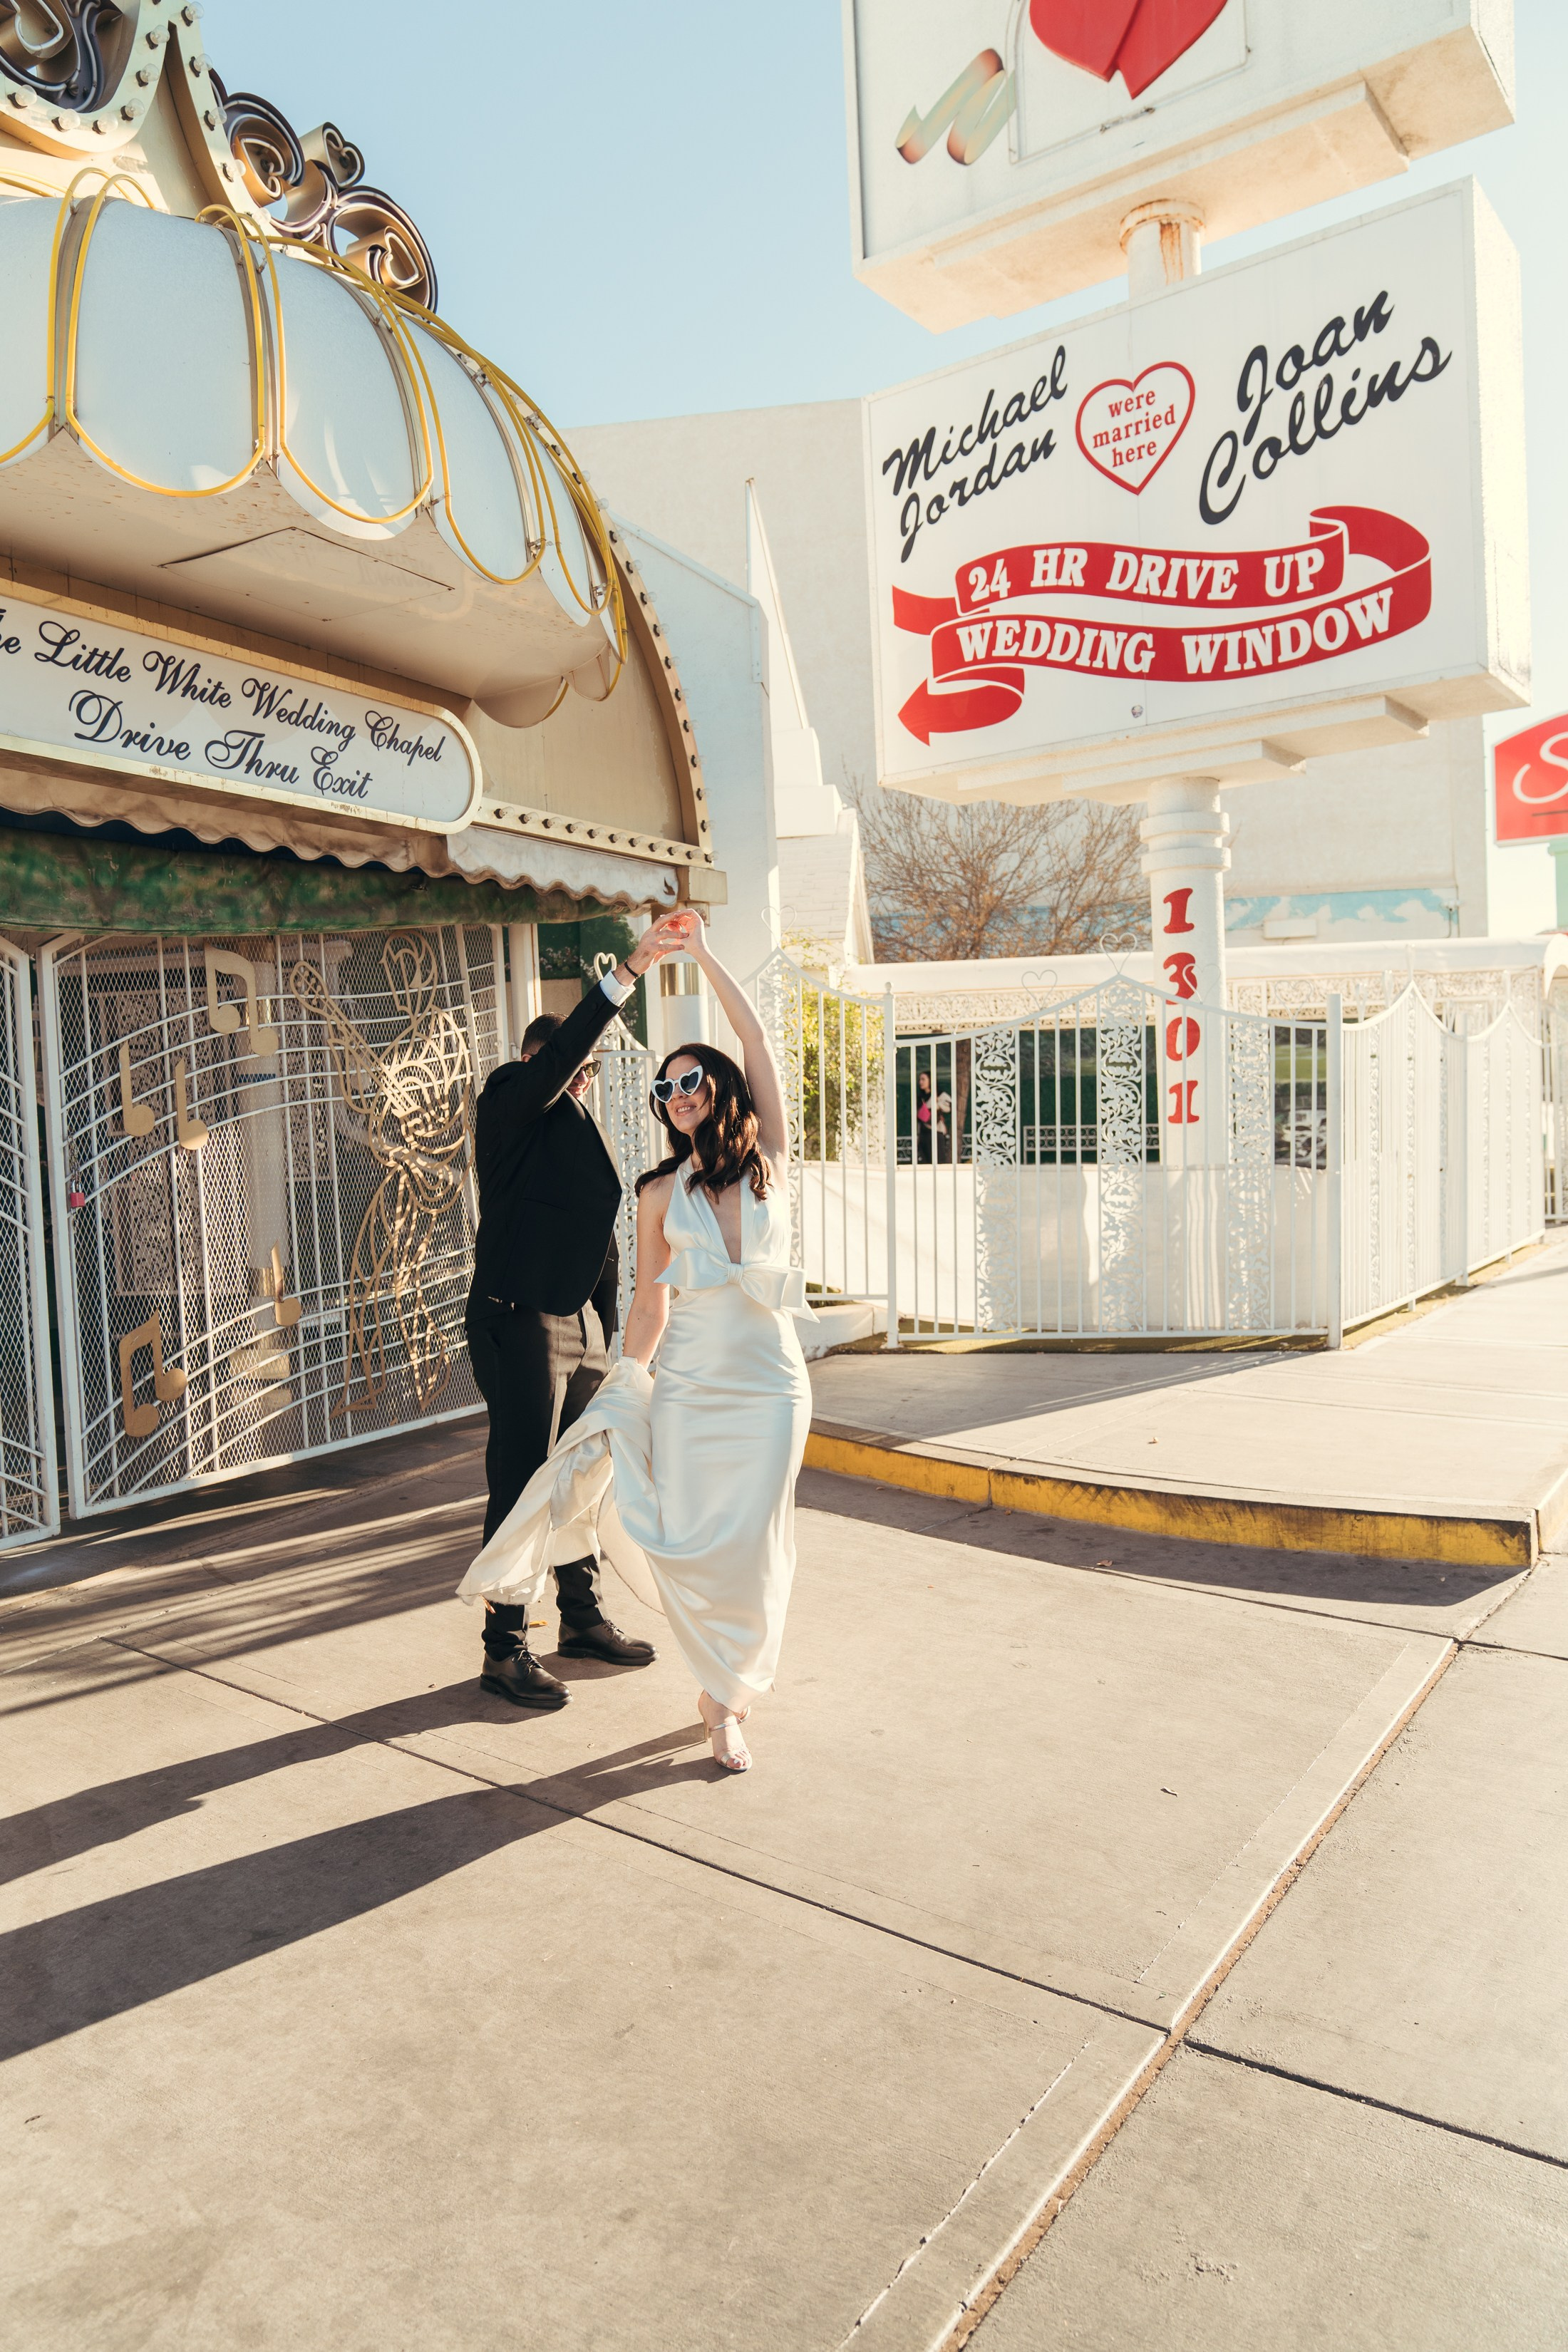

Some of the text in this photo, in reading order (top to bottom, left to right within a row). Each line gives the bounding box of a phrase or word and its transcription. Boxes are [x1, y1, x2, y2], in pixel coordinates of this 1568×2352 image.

[882, 345, 1068, 497] Michael
[1093, 403, 1176, 449] married
[1108, 390, 1156, 418] were
[1237, 290, 1395, 448] Joan
[1112, 441, 1157, 468] here
[1199, 336, 1453, 525] Collins
[900, 428, 1057, 563] Jordan
[956, 587, 1393, 674] WEDDING WINDOW
[968, 547, 1325, 602] 24 HR DRIVE UP
[33, 620, 132, 683] Little
[142, 650, 232, 708] White
[241, 677, 356, 753] Wedding
[364, 710, 446, 766] Chapel
[68, 689, 373, 799] Drive Thru Exit
[1162, 887, 1201, 1125] 1301
